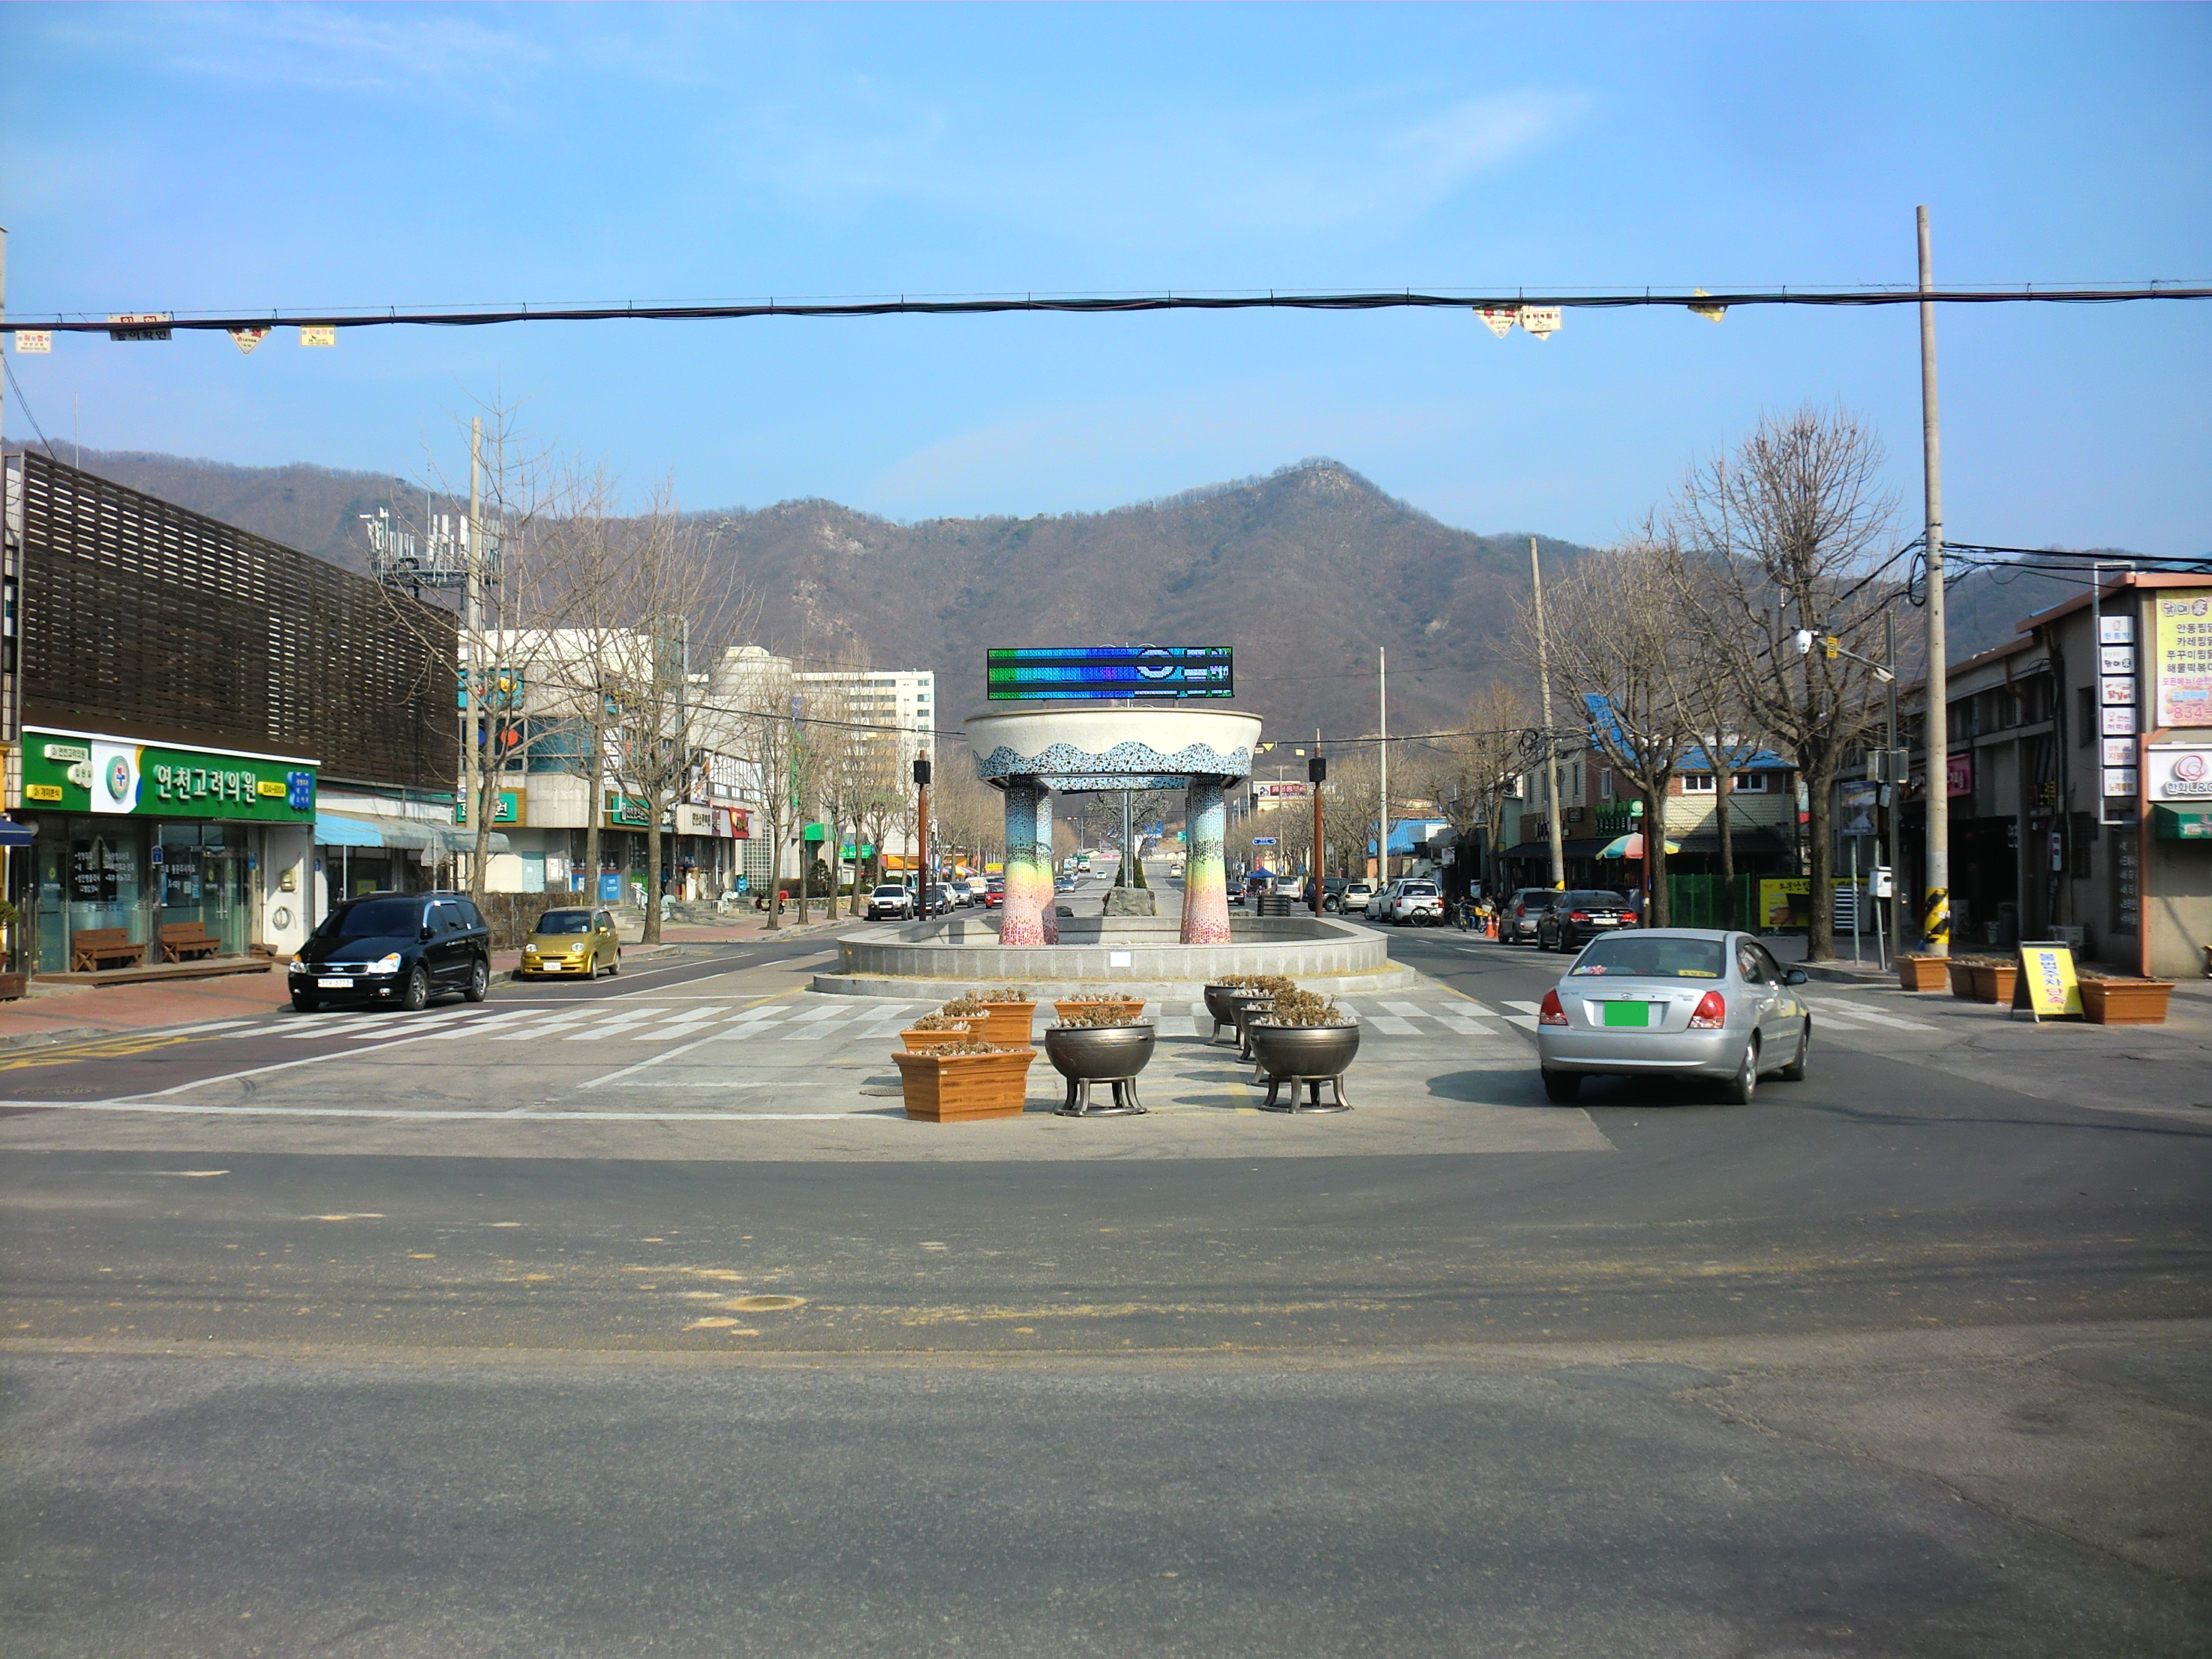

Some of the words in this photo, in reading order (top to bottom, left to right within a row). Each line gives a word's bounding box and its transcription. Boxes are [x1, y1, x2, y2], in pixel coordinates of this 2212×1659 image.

[115, 330, 167, 341] 높이확인
[59, 747, 85, 758] 연천고려의원
[157, 764, 256, 803] 연천고려의원
